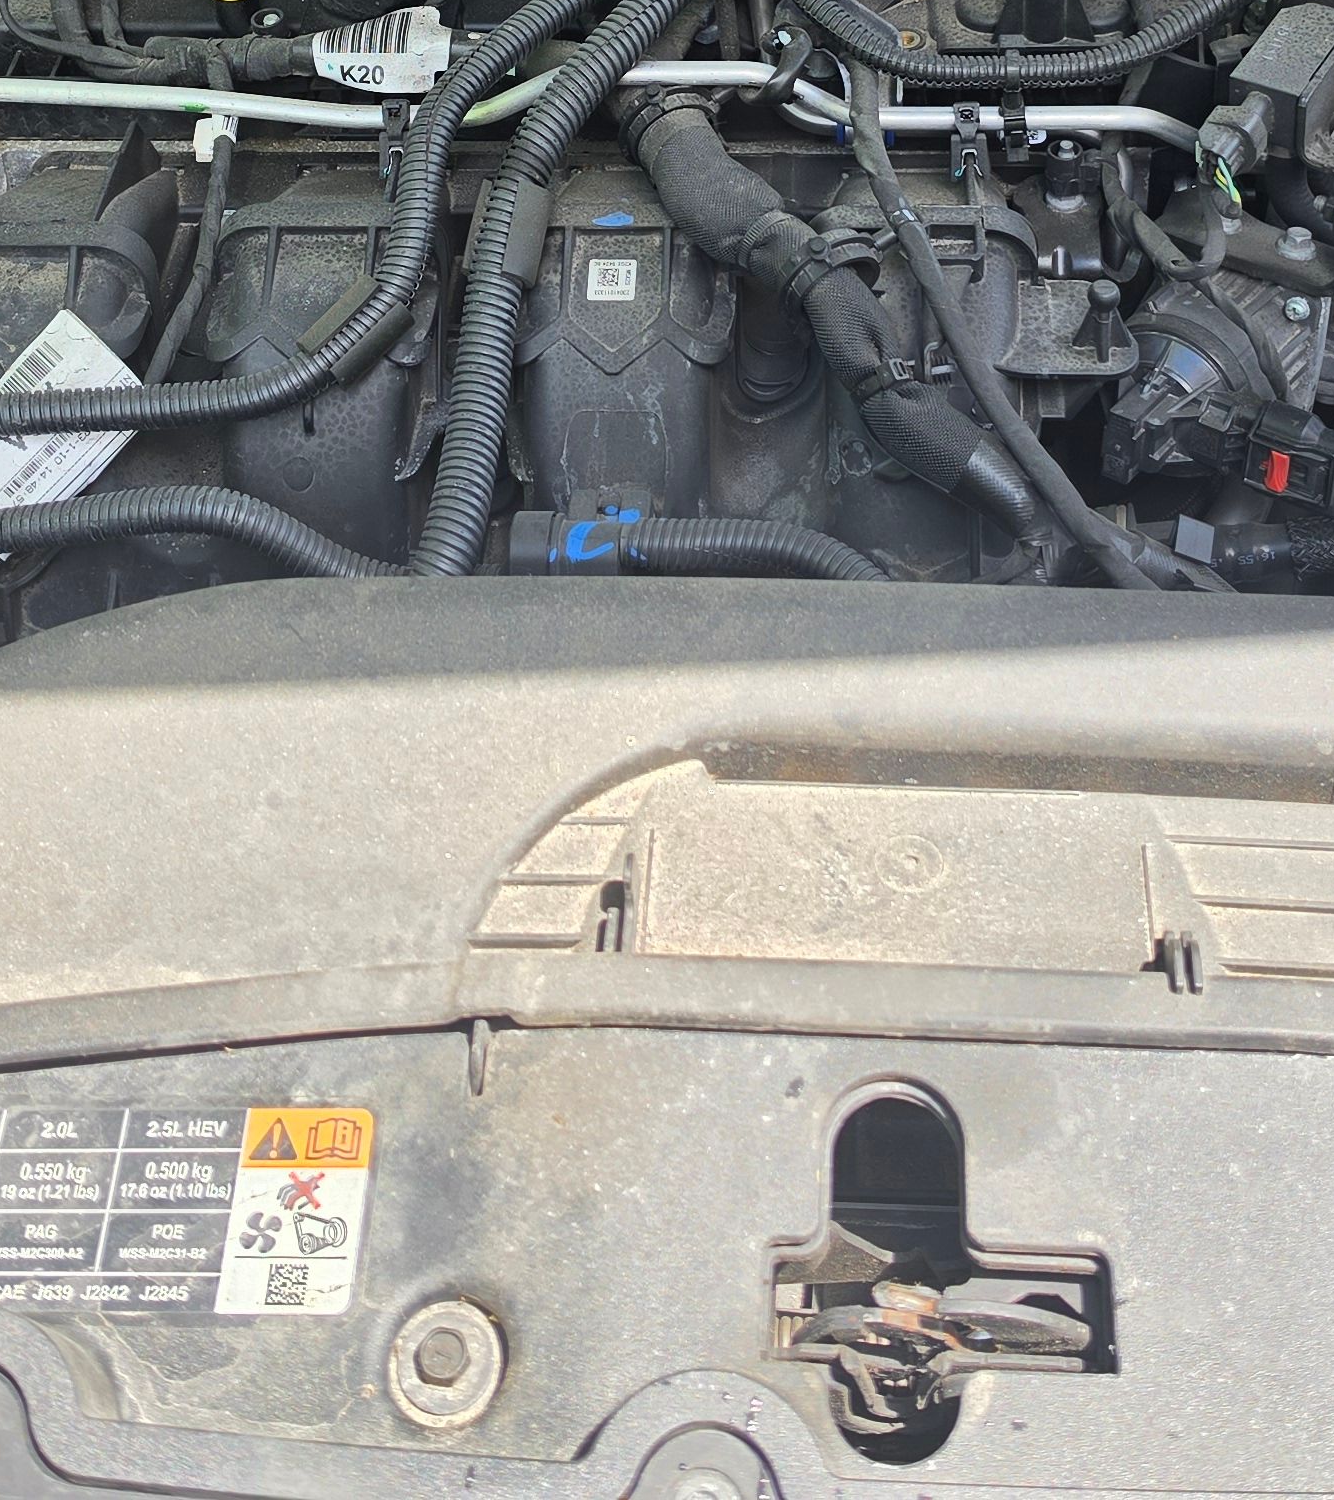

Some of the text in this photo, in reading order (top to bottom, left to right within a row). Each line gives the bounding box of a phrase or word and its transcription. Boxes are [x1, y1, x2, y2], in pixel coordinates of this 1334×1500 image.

[350, 75, 385, 95] K20
[40, 1121, 78, 1139] 2.0L
[146, 1120, 227, 1138] 2.5L HEV
[19, 1162, 88, 1184] 0.550 kg
[145, 1162, 213, 1183] 0.500 kg
[0, 1184, 100, 1201] 19 oz (1.21 lbs)
[120, 1183, 232, 1201] 17.6 oz (1.10 lbs)
[24, 1224, 58, 1240] PAG
[152, 1224, 186, 1240] POE
[32, 1285, 74, 1300] J639
[80, 1285, 130, 1300] J2842
[138, 1285, 189, 1301] J2845
